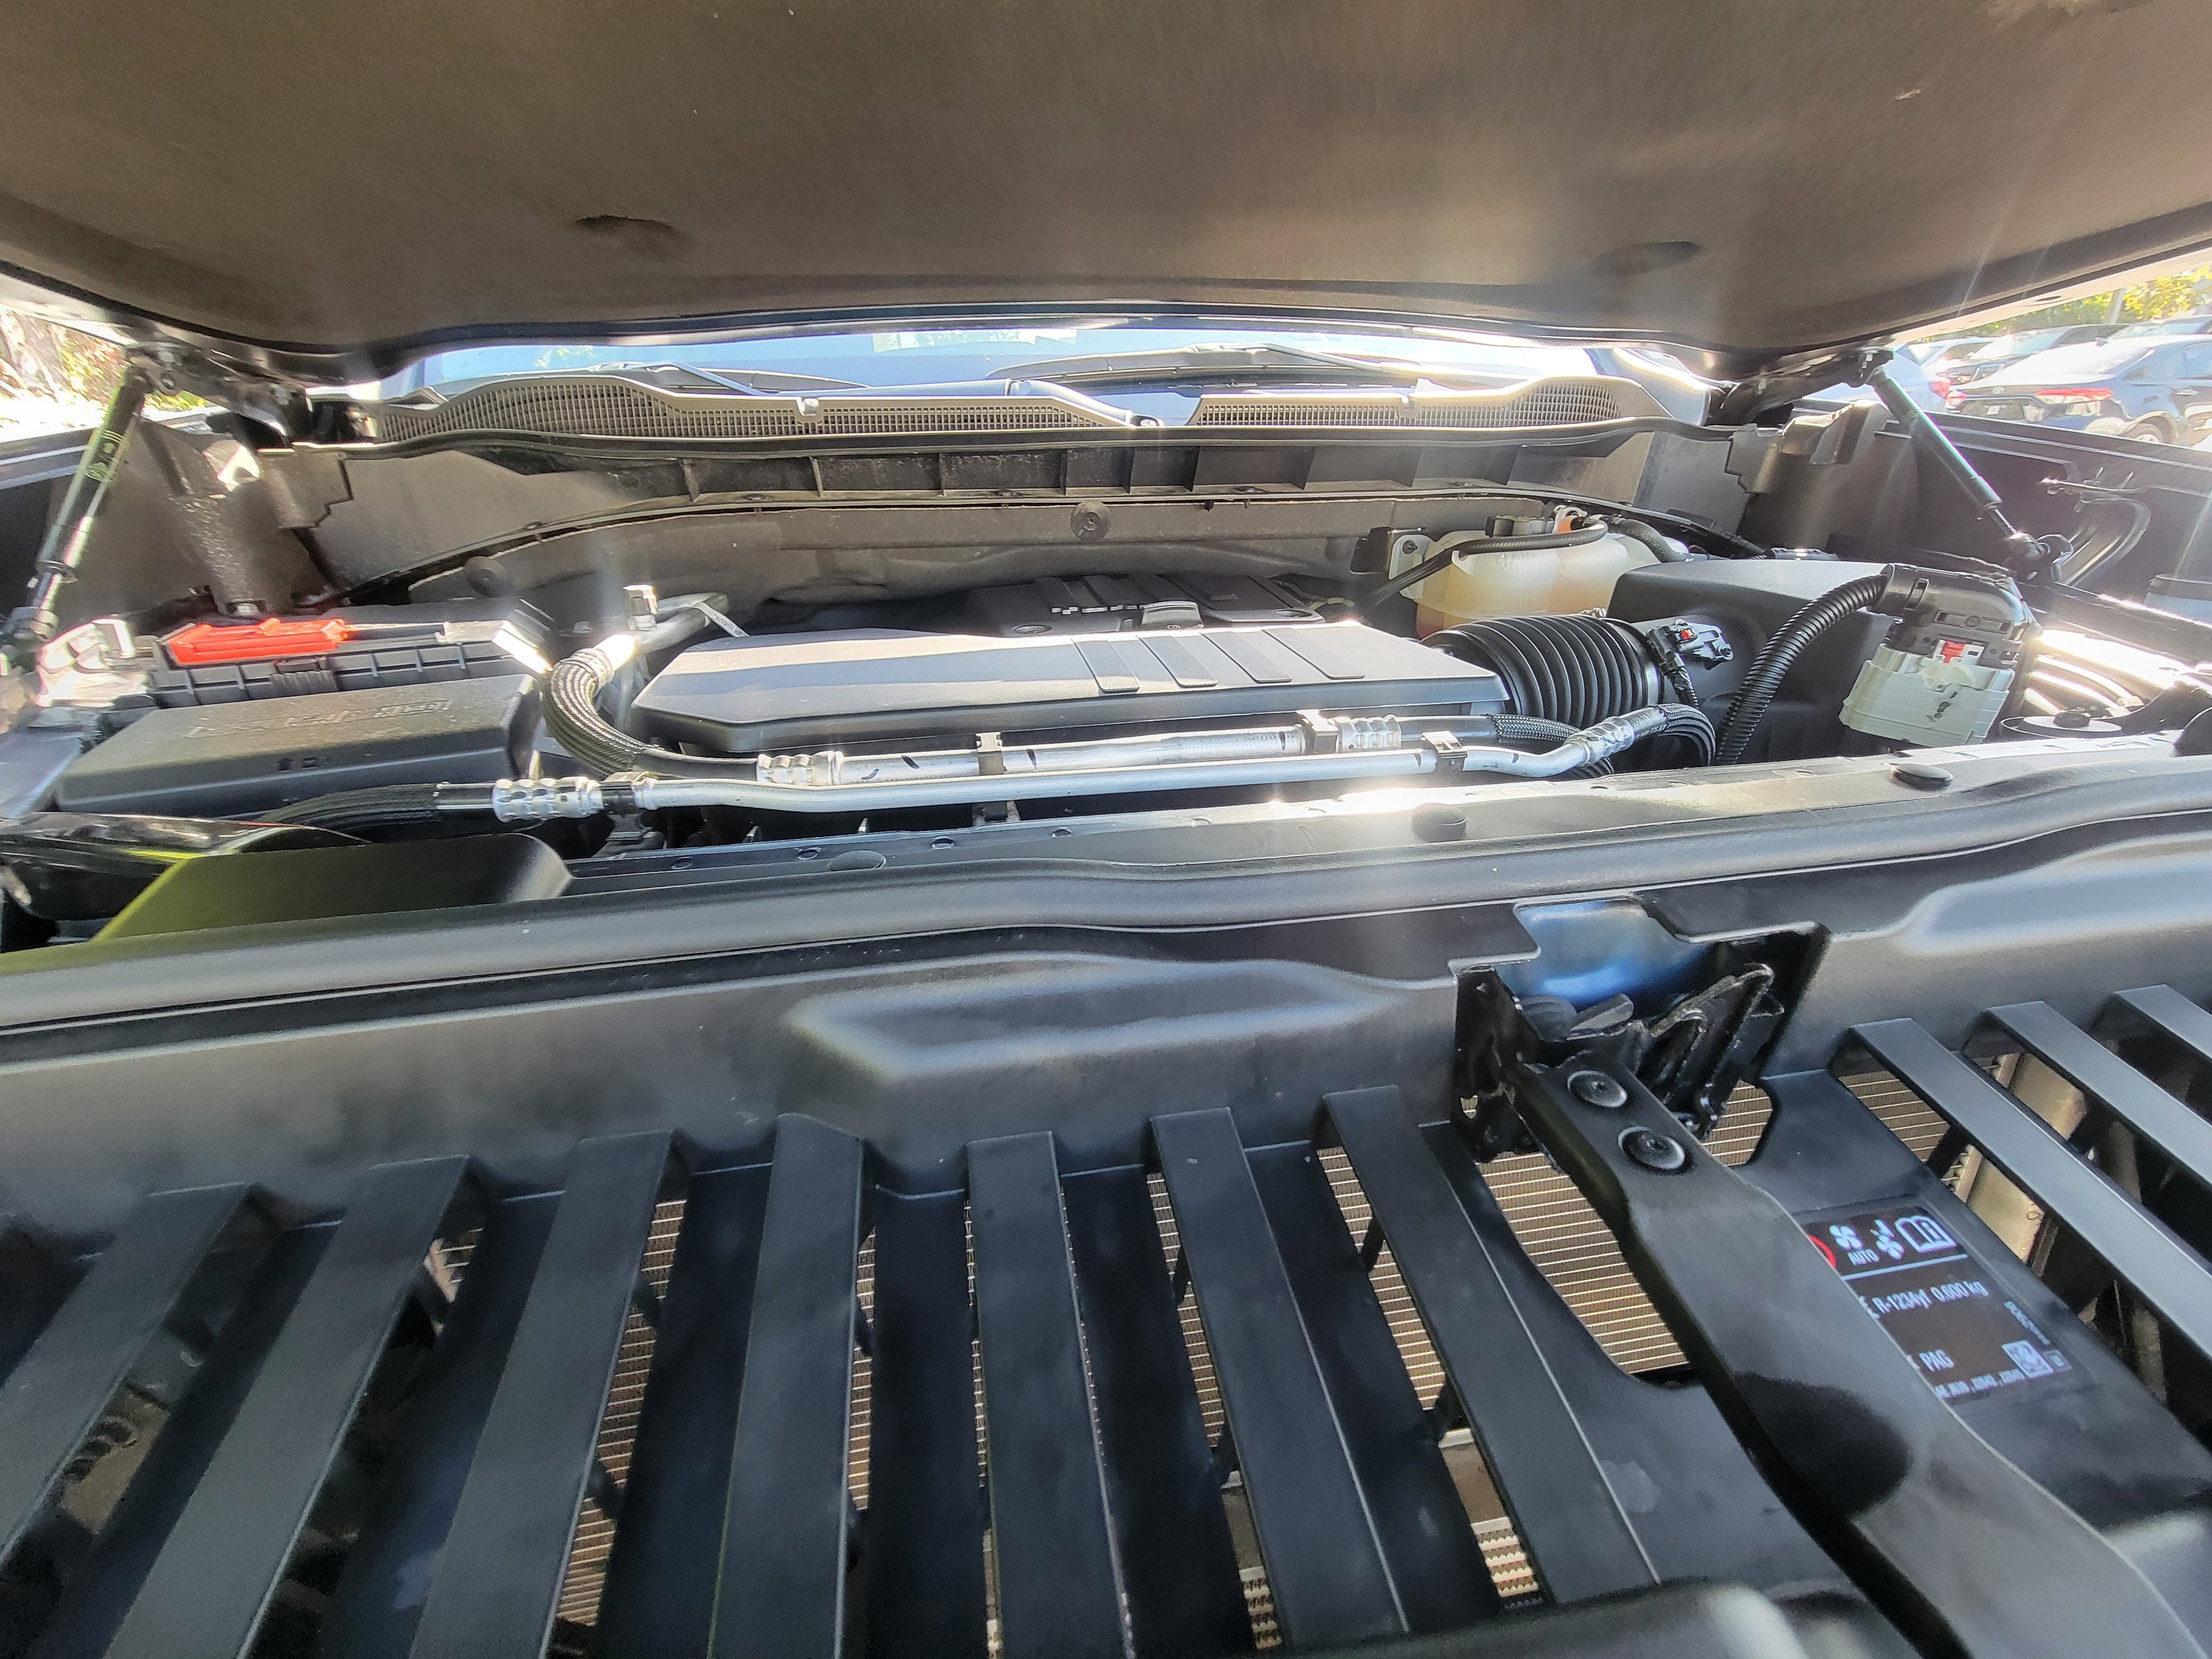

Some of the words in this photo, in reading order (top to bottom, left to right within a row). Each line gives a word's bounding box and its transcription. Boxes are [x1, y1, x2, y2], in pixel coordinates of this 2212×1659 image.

[1847, 1248, 1880, 1266] AUTO
[1872, 1289, 1932, 1314] R-1234yf
[1930, 1282, 1970, 1302] 0.600
[1963, 1279, 1989, 1297] kg
[1919, 1349, 1955, 1372] PAG
